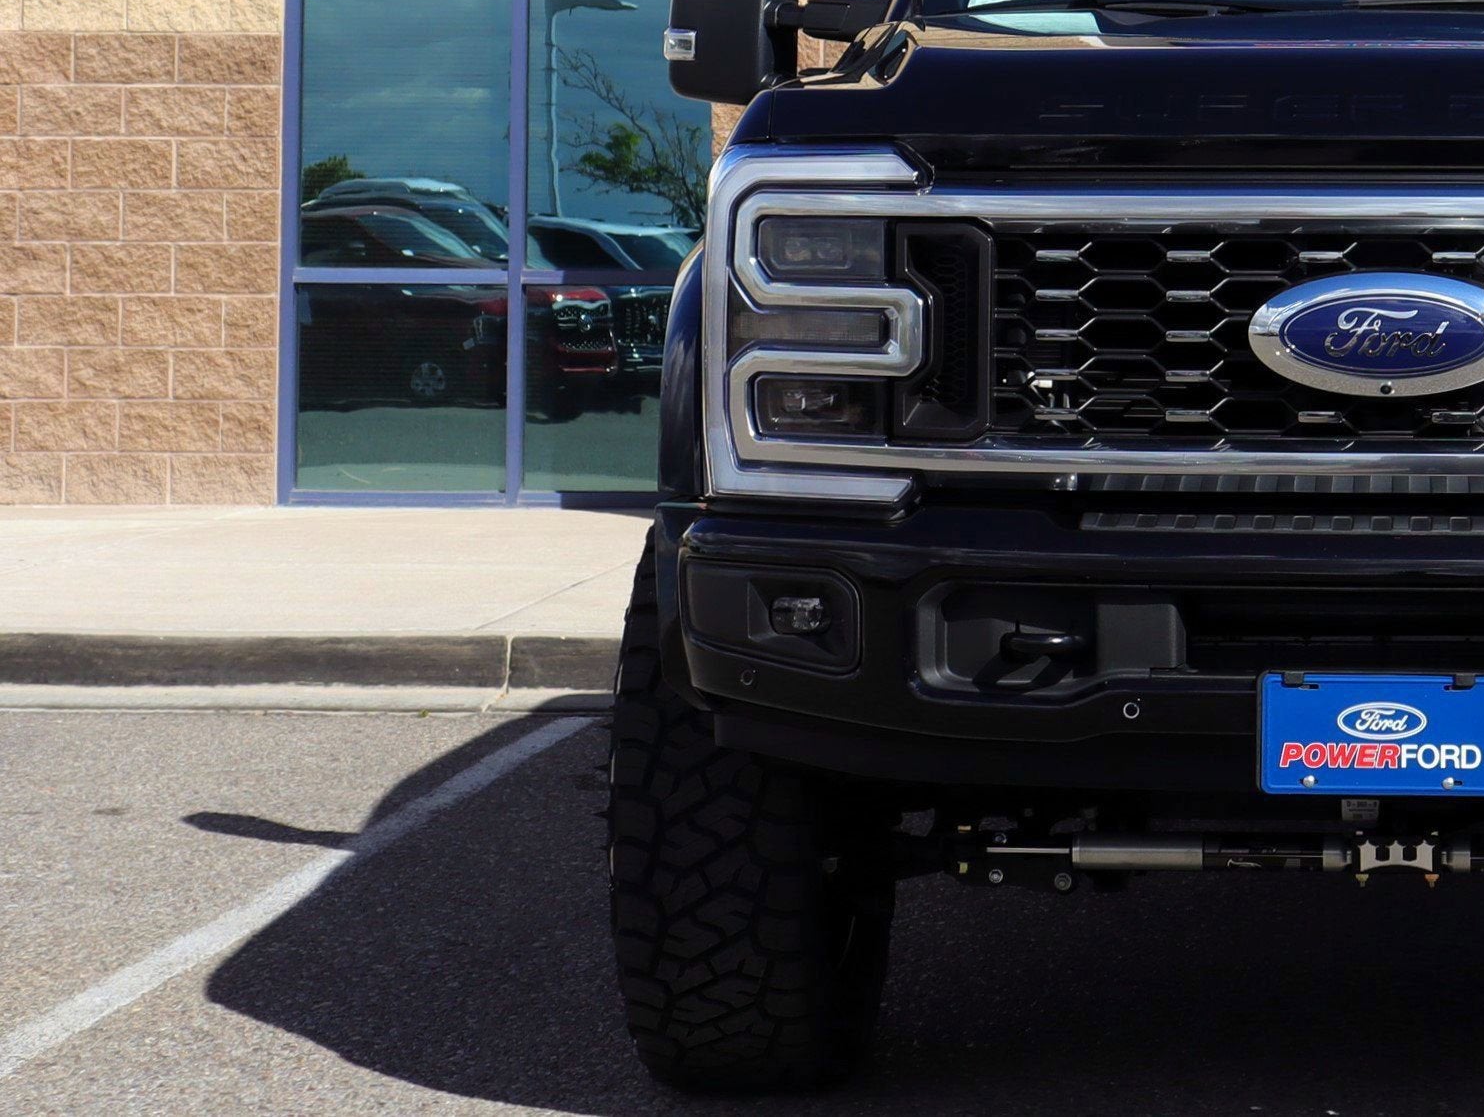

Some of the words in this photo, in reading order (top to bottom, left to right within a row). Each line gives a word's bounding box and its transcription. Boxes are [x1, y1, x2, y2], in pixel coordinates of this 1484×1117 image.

[1323, 307, 1450, 358] Ford
[1355, 709, 1408, 731] Ford
[1279, 742, 1482, 770] POWERFORD
